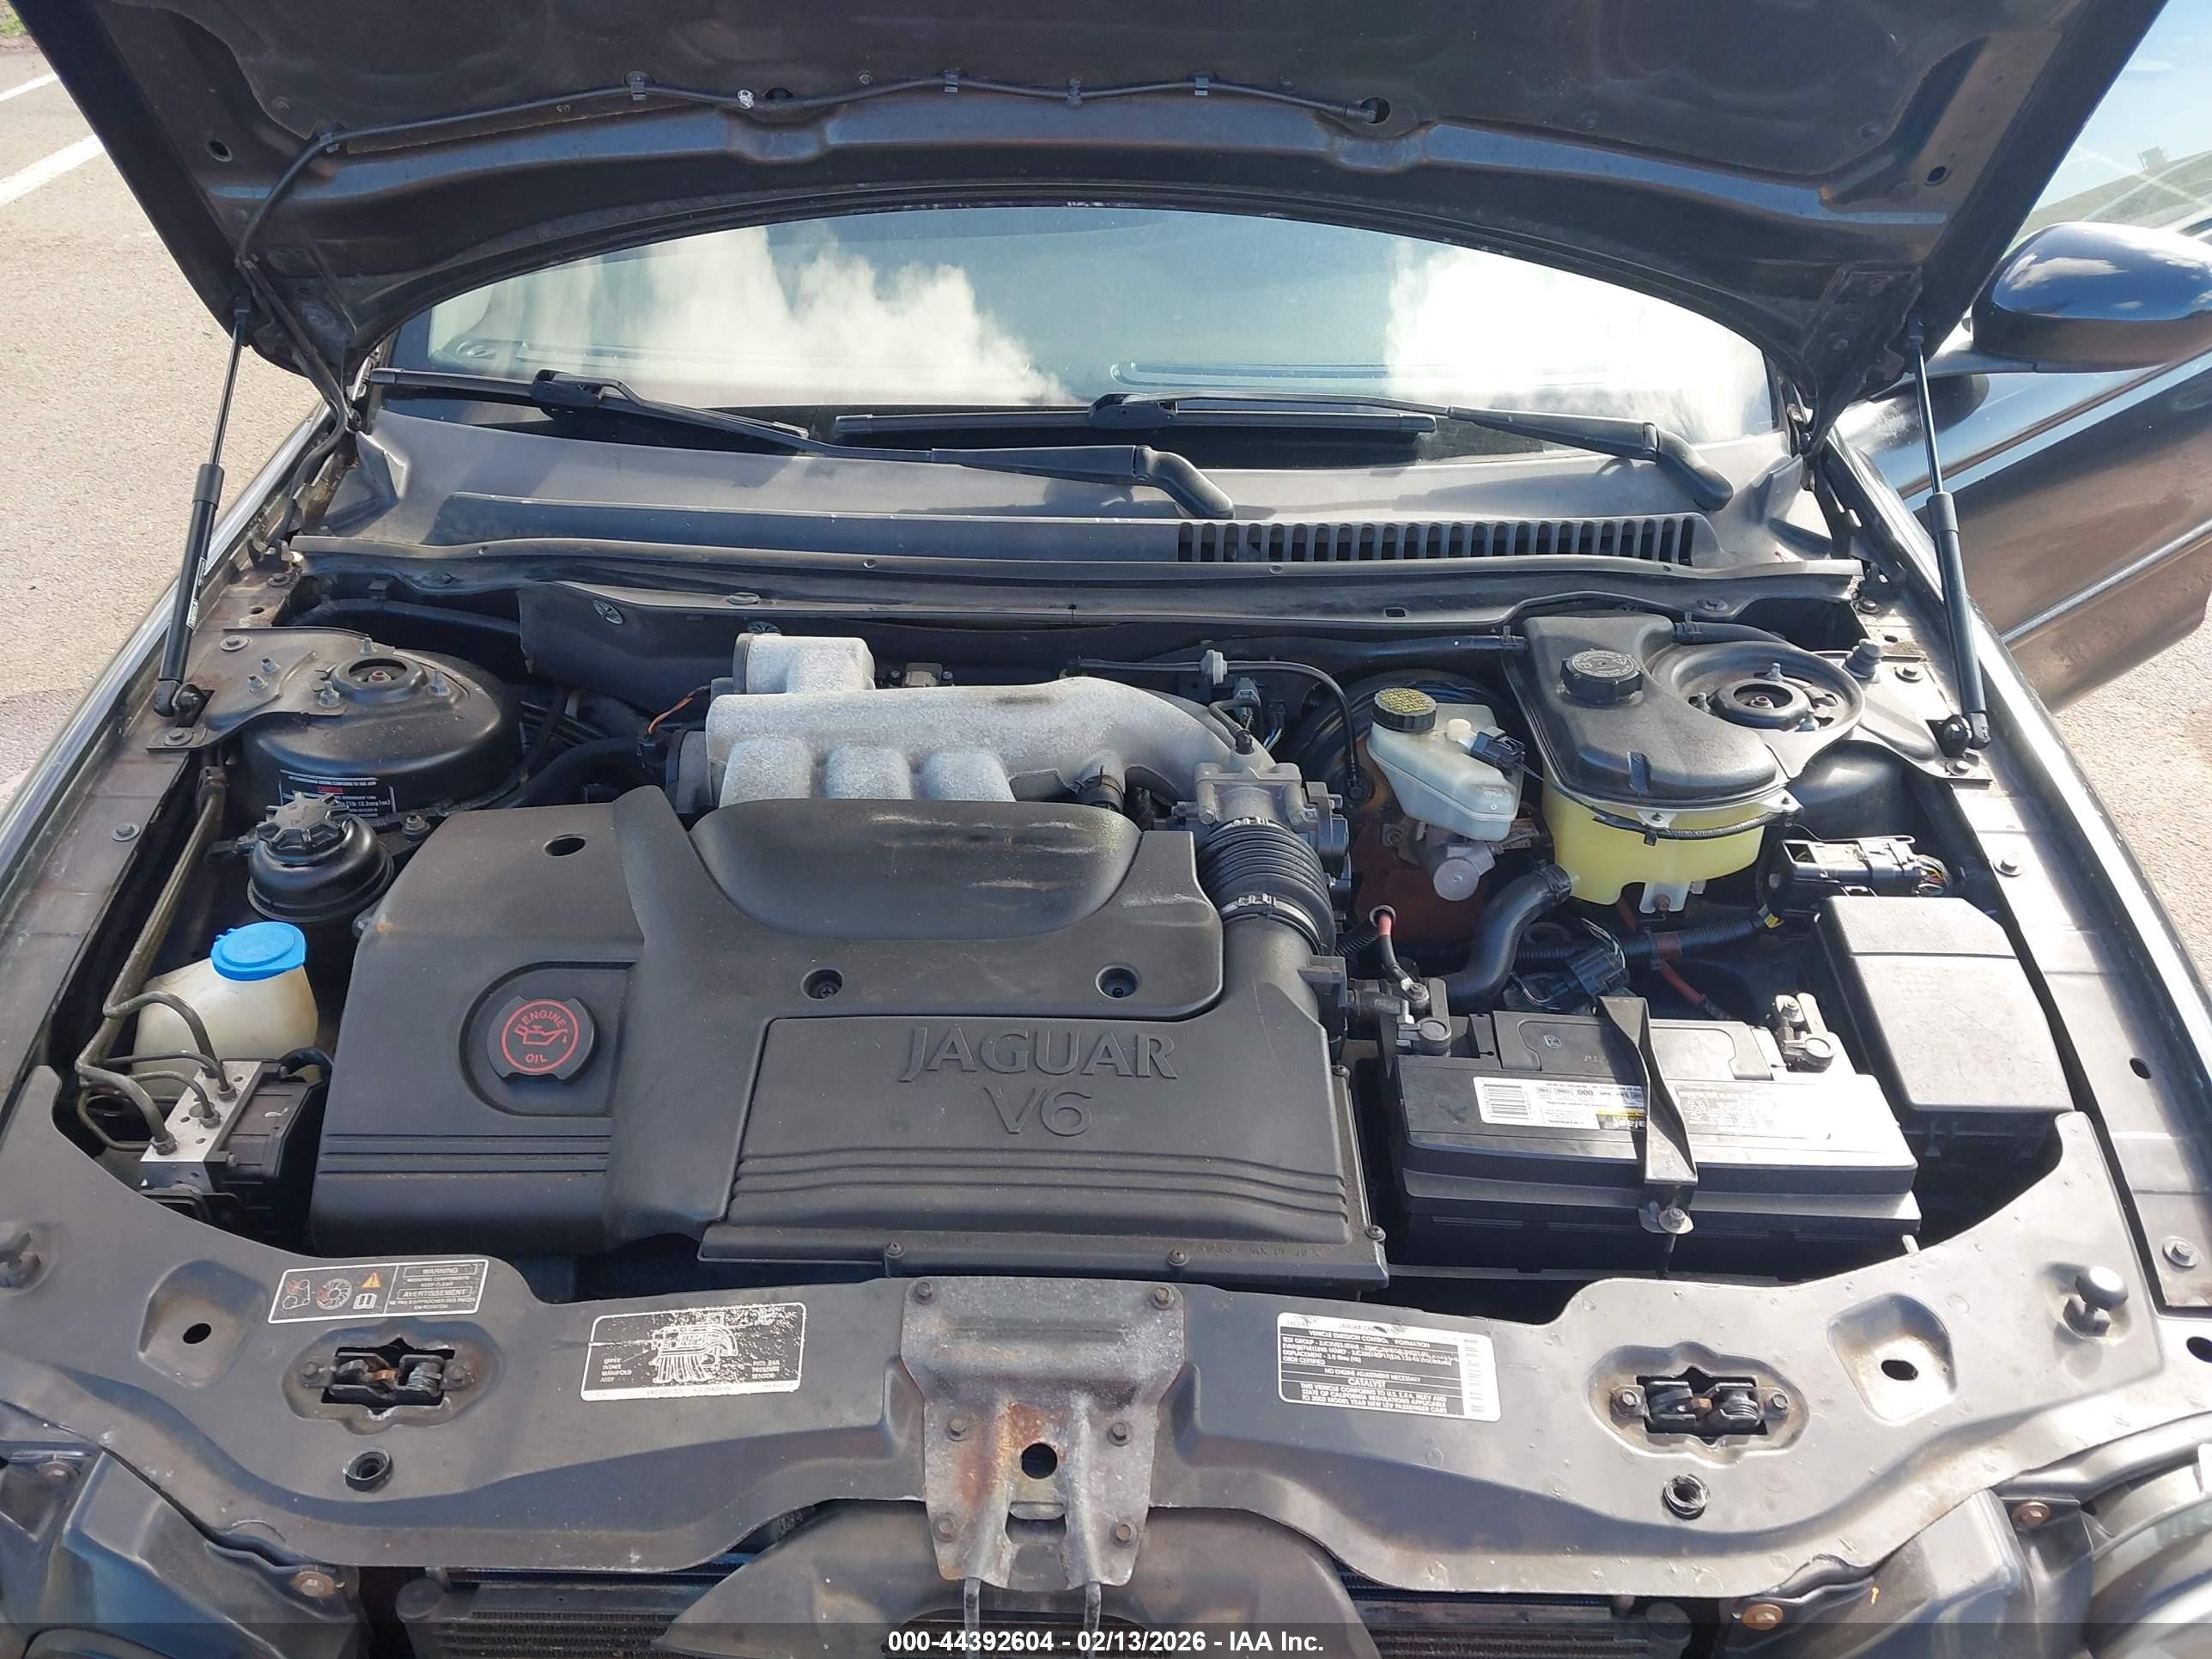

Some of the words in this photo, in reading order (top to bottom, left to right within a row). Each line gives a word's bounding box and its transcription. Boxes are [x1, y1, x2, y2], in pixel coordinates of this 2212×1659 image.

[521, 1010, 568, 1029] ENGINE
[525, 1053, 548, 1064] OIL
[897, 1025, 1179, 1084] JAGUAR
[984, 1085, 1093, 1137] V6
[422, 1267, 459, 1275] WARNING
[402, 1289, 467, 1298] AVERTISSEMENT
[1347, 1378, 1386, 1389] CATALYST
